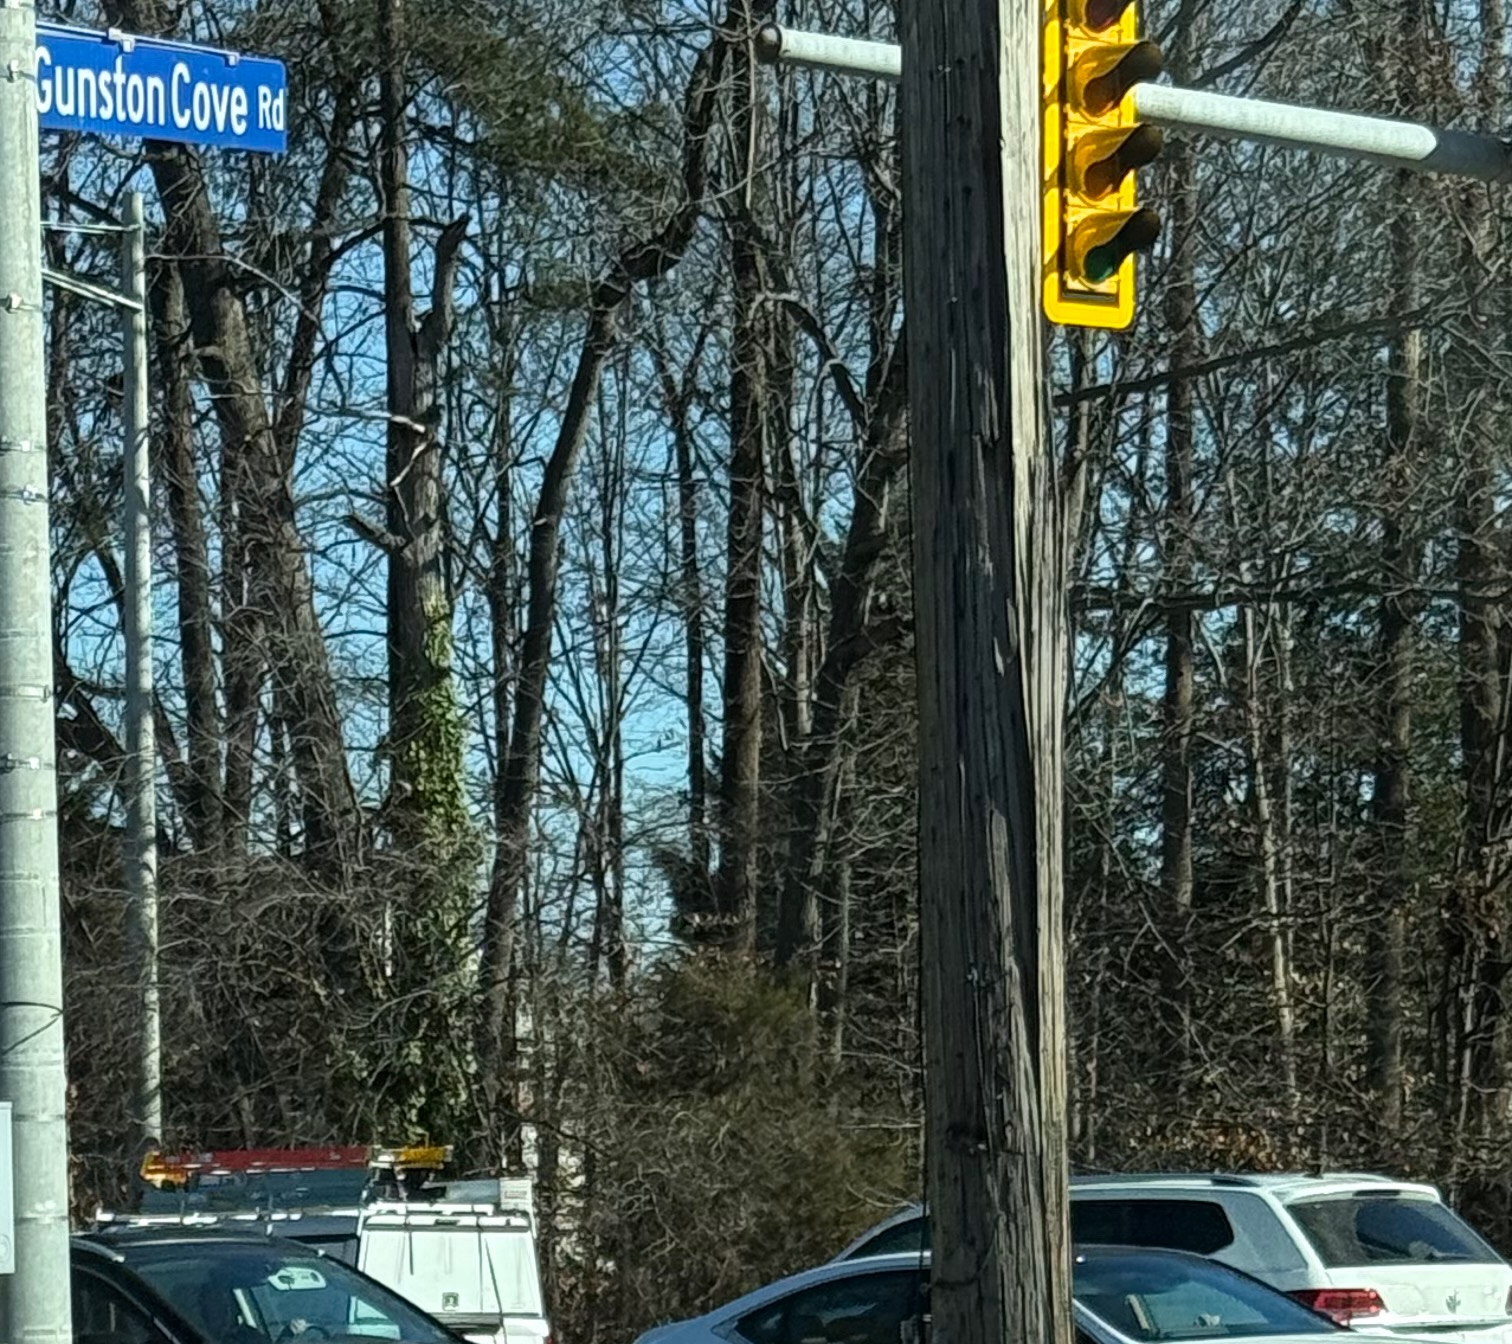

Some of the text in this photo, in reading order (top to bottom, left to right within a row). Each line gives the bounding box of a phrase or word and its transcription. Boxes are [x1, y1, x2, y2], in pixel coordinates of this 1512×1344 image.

[36, 46, 284, 135] Gunston Cove Rd
